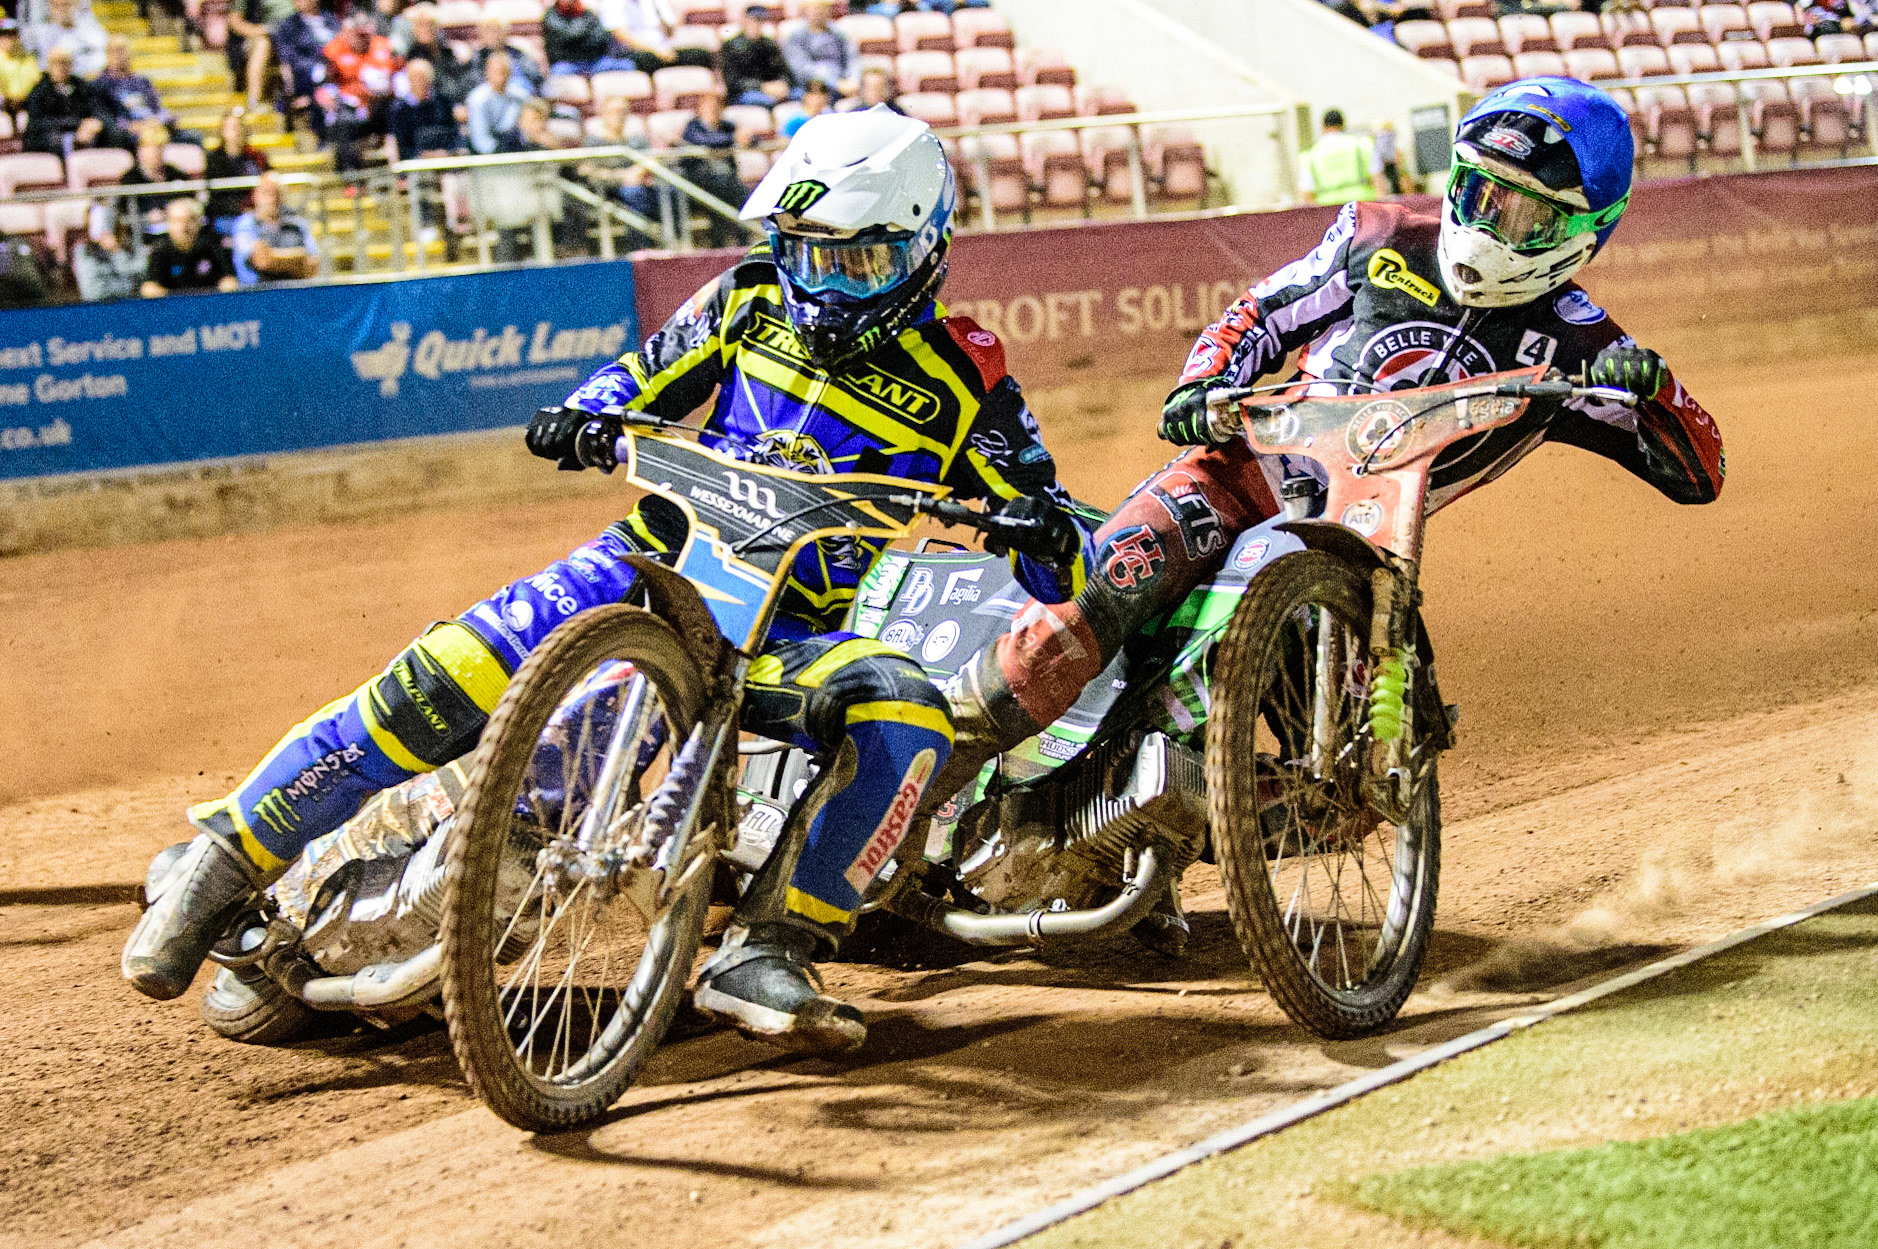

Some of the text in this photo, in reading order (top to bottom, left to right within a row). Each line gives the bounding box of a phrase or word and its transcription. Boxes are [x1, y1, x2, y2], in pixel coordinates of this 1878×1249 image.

[1374, 255, 1435, 301] Rentruck
[1117, 278, 1252, 335] SOLIC
[47, 335, 144, 366] Service
[149, 327, 197, 357] and
[201, 319, 261, 351] MOT
[413, 324, 527, 380] Quick
[527, 321, 631, 364] Lane
[1373, 330, 1432, 359] BELLE
[1523, 335, 1551, 367] 4
[34, 373, 128, 403] Gorton
[689, 485, 796, 542] WESSEXMARNE
[1177, 493, 1226, 558] FTS
[523, 571, 578, 616] Nice
